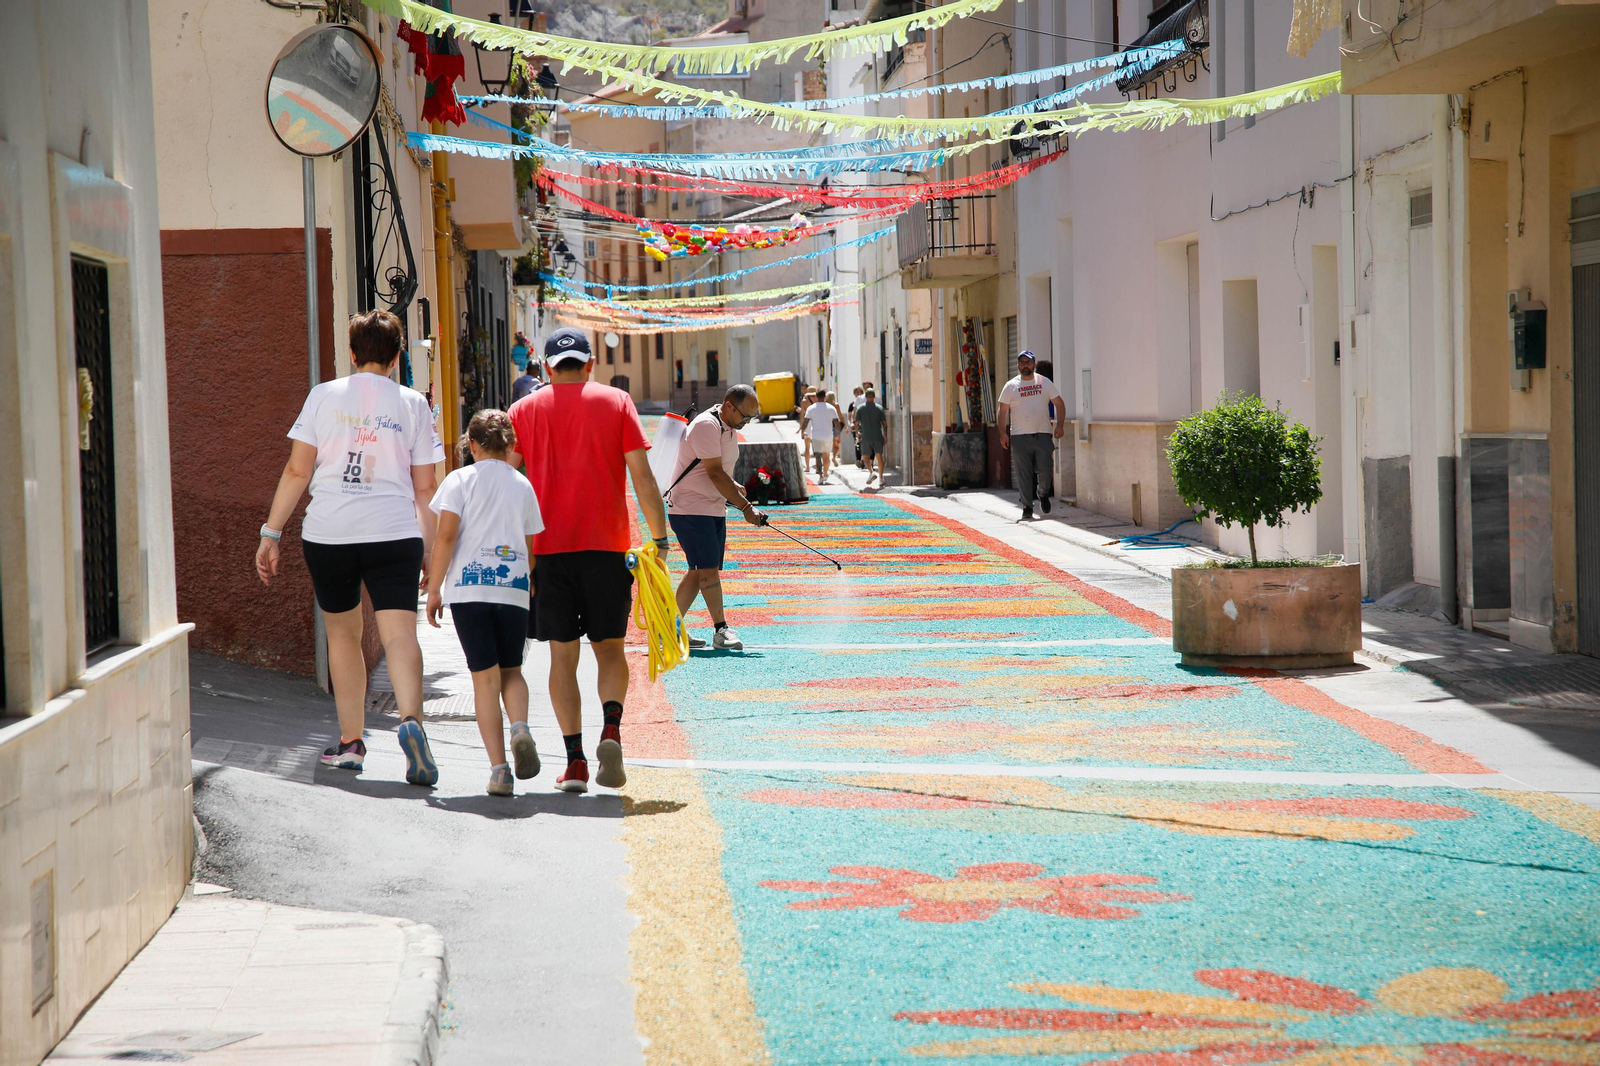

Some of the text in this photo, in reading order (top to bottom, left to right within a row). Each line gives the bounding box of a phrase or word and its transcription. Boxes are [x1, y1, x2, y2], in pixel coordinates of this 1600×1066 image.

[363, 414, 371, 426] de
[347, 450, 363, 464] TÍ
[343, 464, 362, 476] JO
